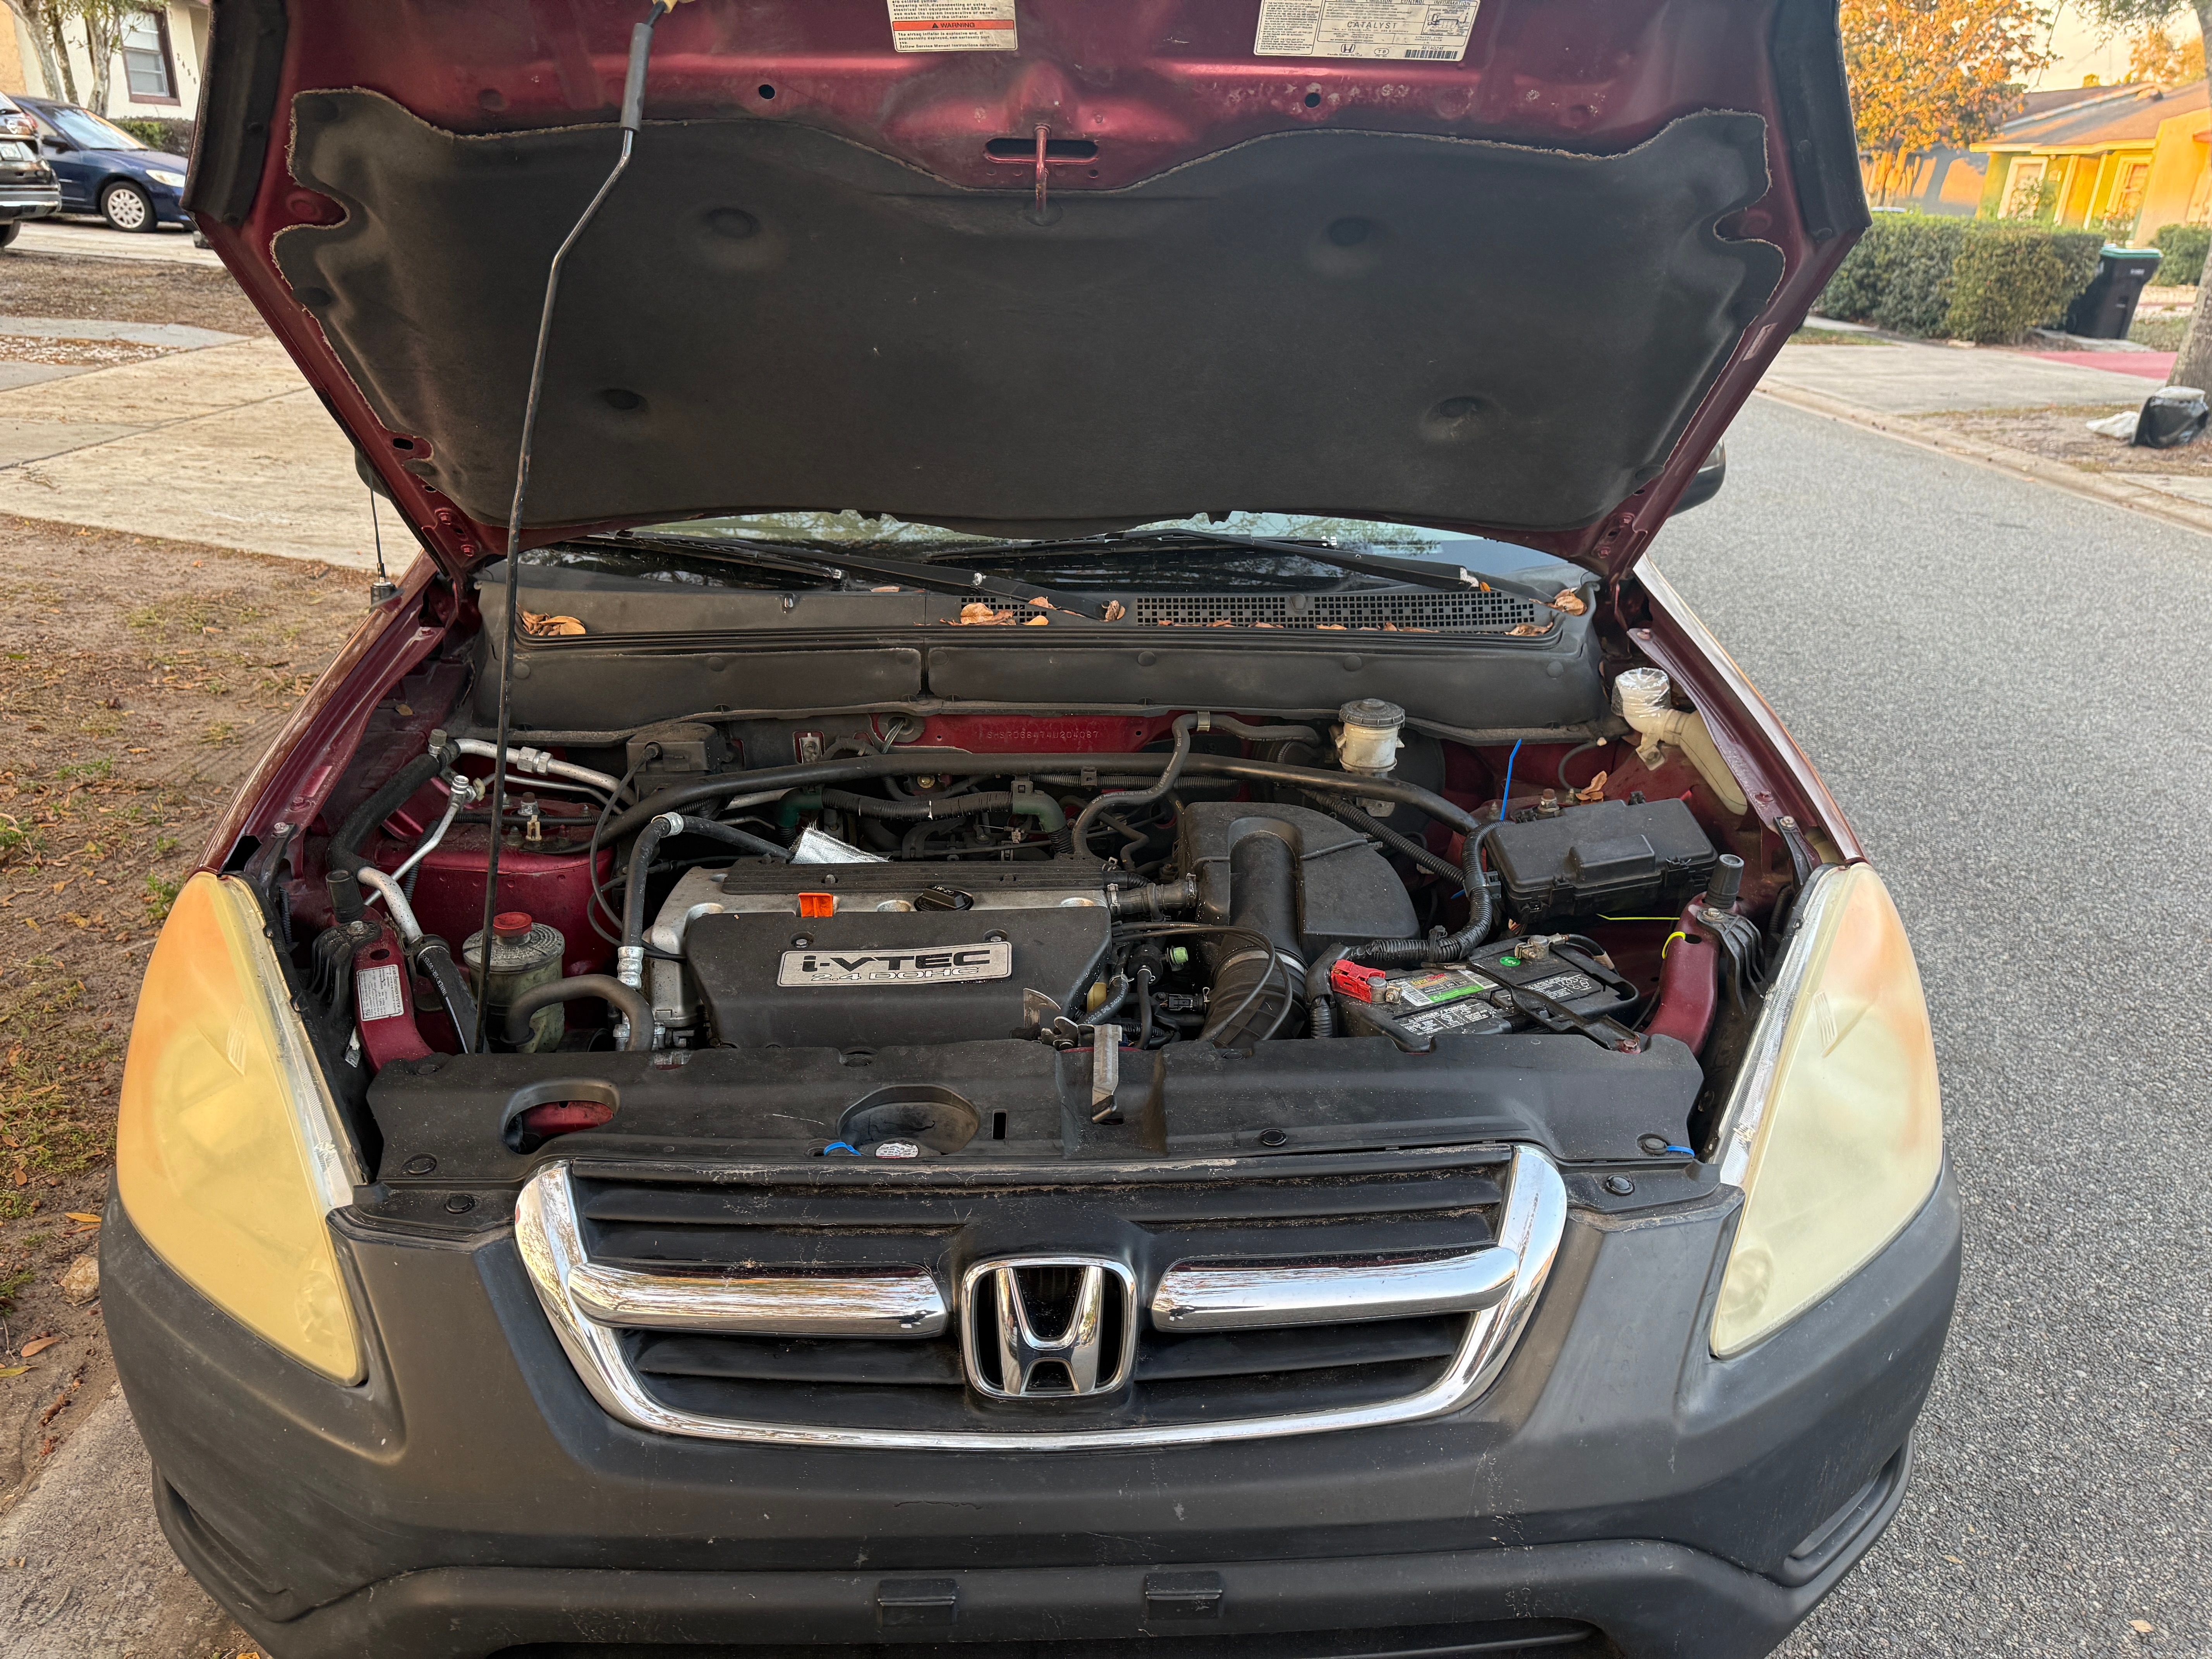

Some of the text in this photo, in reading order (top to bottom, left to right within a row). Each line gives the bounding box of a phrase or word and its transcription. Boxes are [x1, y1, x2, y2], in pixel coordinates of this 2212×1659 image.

[802, 949, 990, 972] i-VTEC
[811, 967, 980, 982] 2.4 DOHC
[1413, 1012, 1439, 1021] DANGER
[1443, 1004, 1467, 1012] POISON
